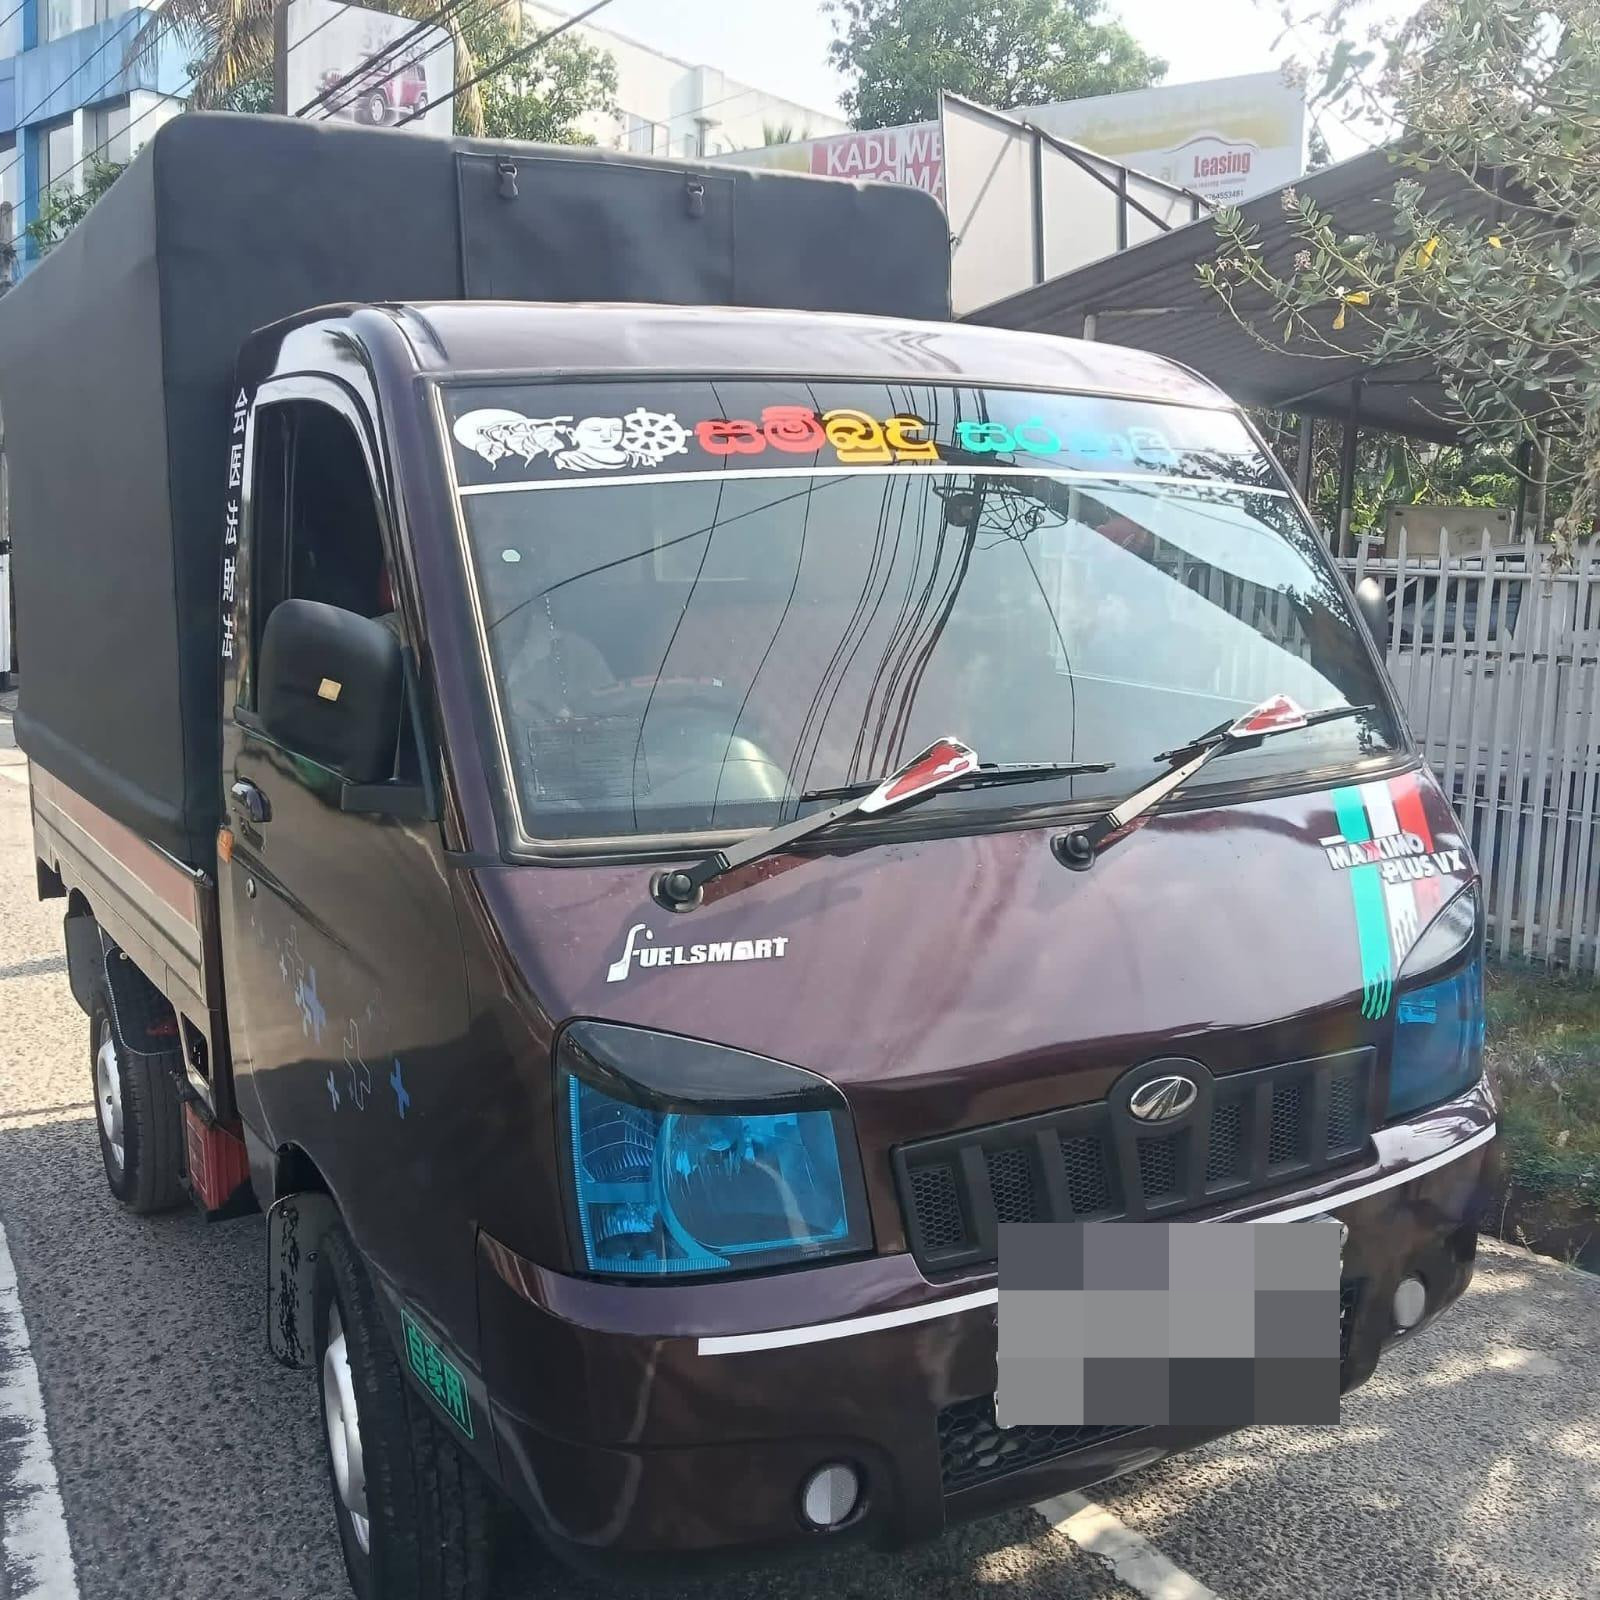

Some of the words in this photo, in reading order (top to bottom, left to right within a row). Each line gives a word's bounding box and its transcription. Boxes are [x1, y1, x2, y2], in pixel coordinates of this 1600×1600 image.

[1194, 152, 1250, 178] Leasing
[1381, 856, 1434, 883] PLUS
[1432, 849, 1466, 873] VX
